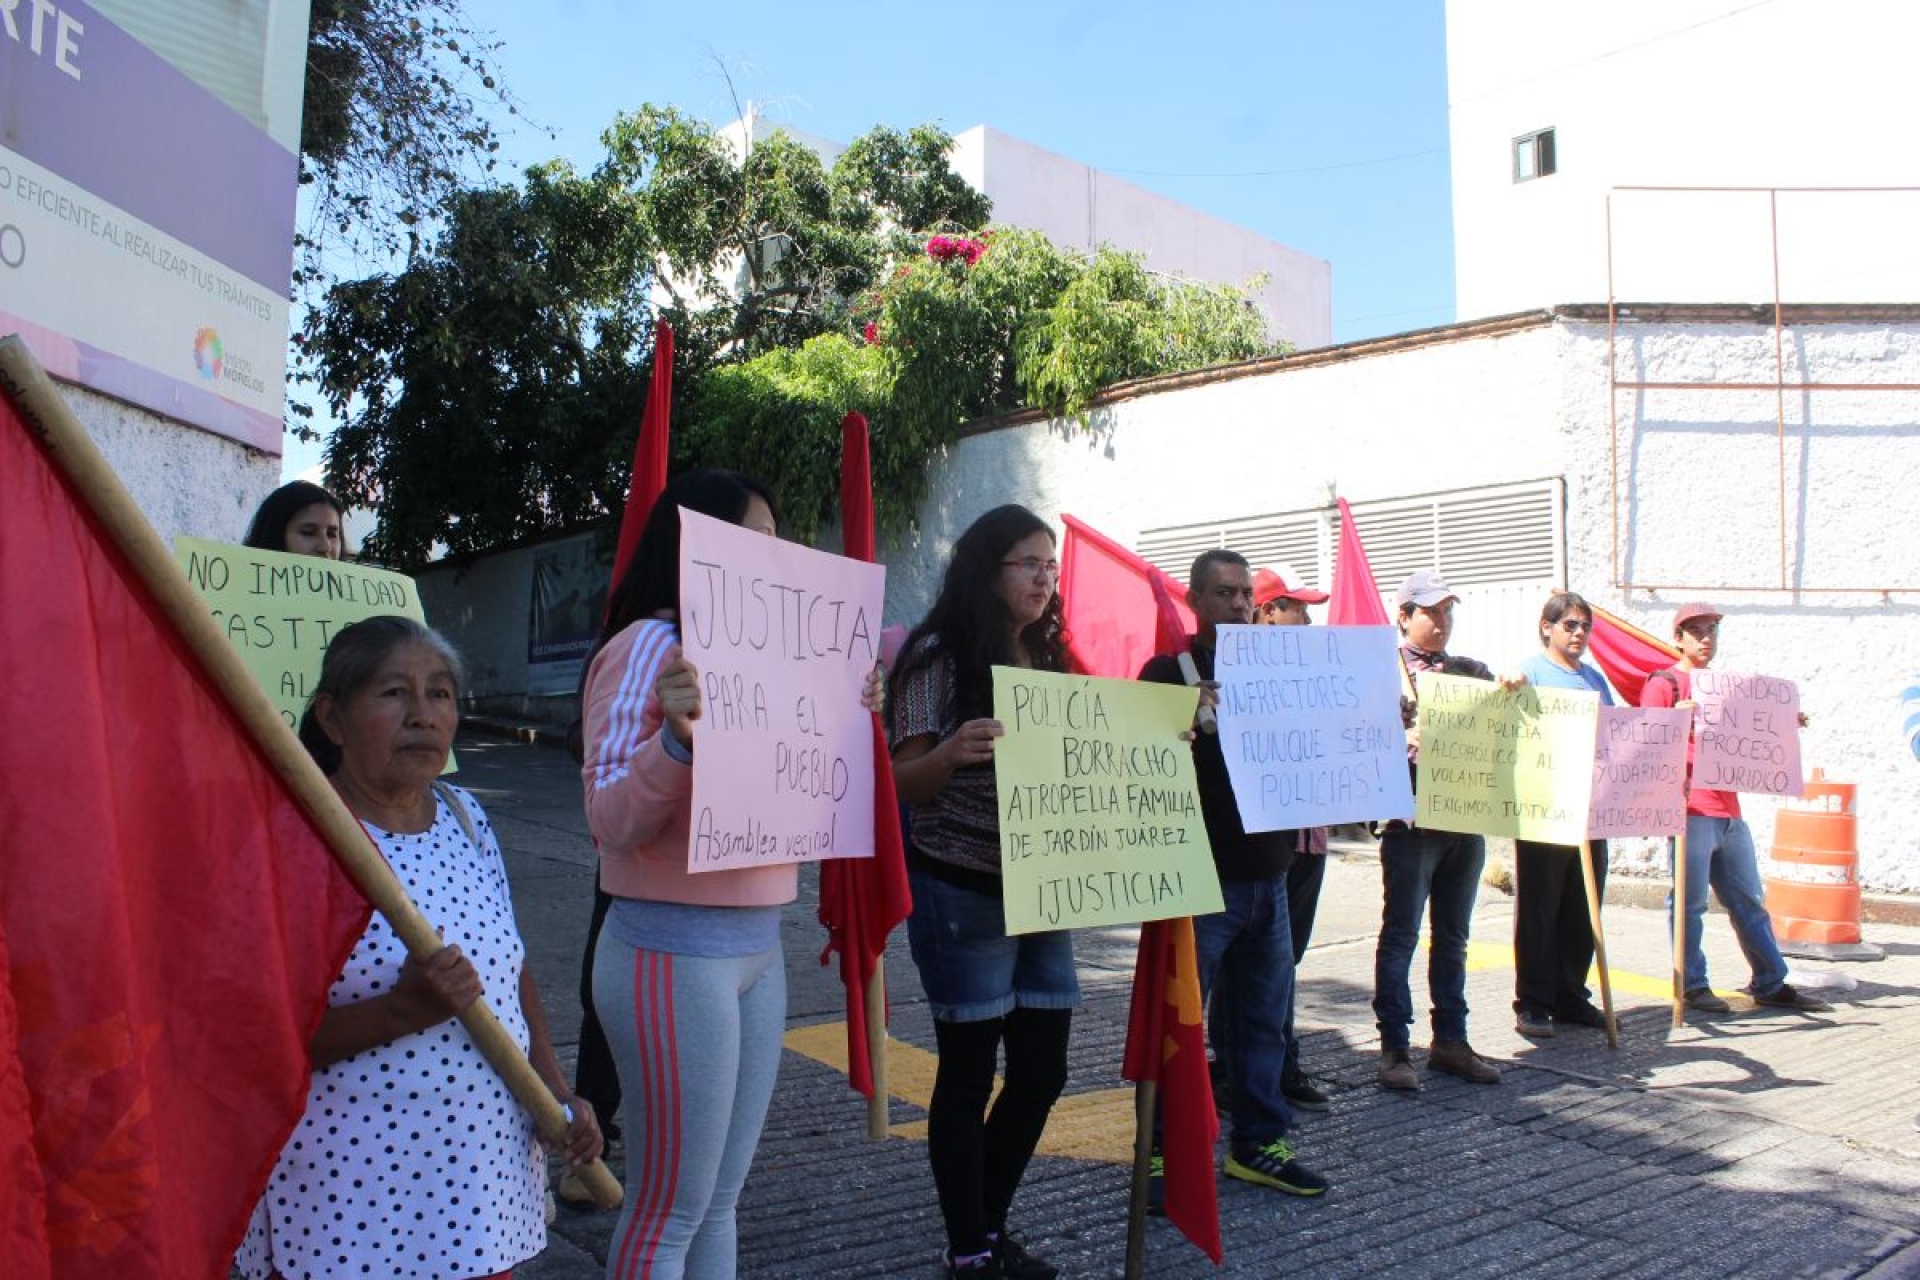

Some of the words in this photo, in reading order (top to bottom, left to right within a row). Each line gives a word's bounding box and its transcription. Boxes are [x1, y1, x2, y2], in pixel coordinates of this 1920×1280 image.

[17, 175, 100, 236] EFICIENTE
[102, 220, 121, 247] AL
[124, 230, 189, 283] REALIZAR
[190, 263, 214, 294] TUS
[216, 276, 272, 322] TRÁMITES
[188, 551, 230, 592] NO
[250, 562, 407, 608] IMPUNIDAD
[211, 610, 355, 651] ASTI
[692, 560, 873, 661] JUSTICIA
[1221, 630, 1309, 668] CARCEL
[1327, 630, 1342, 667] A
[705, 671, 769, 731] PARA
[796, 696, 824, 737] EL
[1013, 680, 1109, 732] POLICÍA
[1224, 674, 1360, 718] INFRACTORES
[1704, 703, 1737, 729] EN
[1753, 711, 1780, 737] EL
[1063, 736, 1178, 778] BORRACHO
[1241, 729, 1325, 764] AUNQUE
[1701, 730, 1786, 766] PROCESO
[776, 742, 848, 802] PUEBLO
[1431, 767, 1498, 788] VOLANTE
[1007, 783, 1120, 822] ATROPELLA
[1126, 783, 1196, 818] FAMILIA
[694, 807, 777, 862] Asamblea
[786, 812, 836, 857] vecinal
[1009, 832, 1032, 861] DE
[1041, 824, 1108, 856] JARDÍN
[1038, 871, 1184, 925] ¡JUSTICIA!
